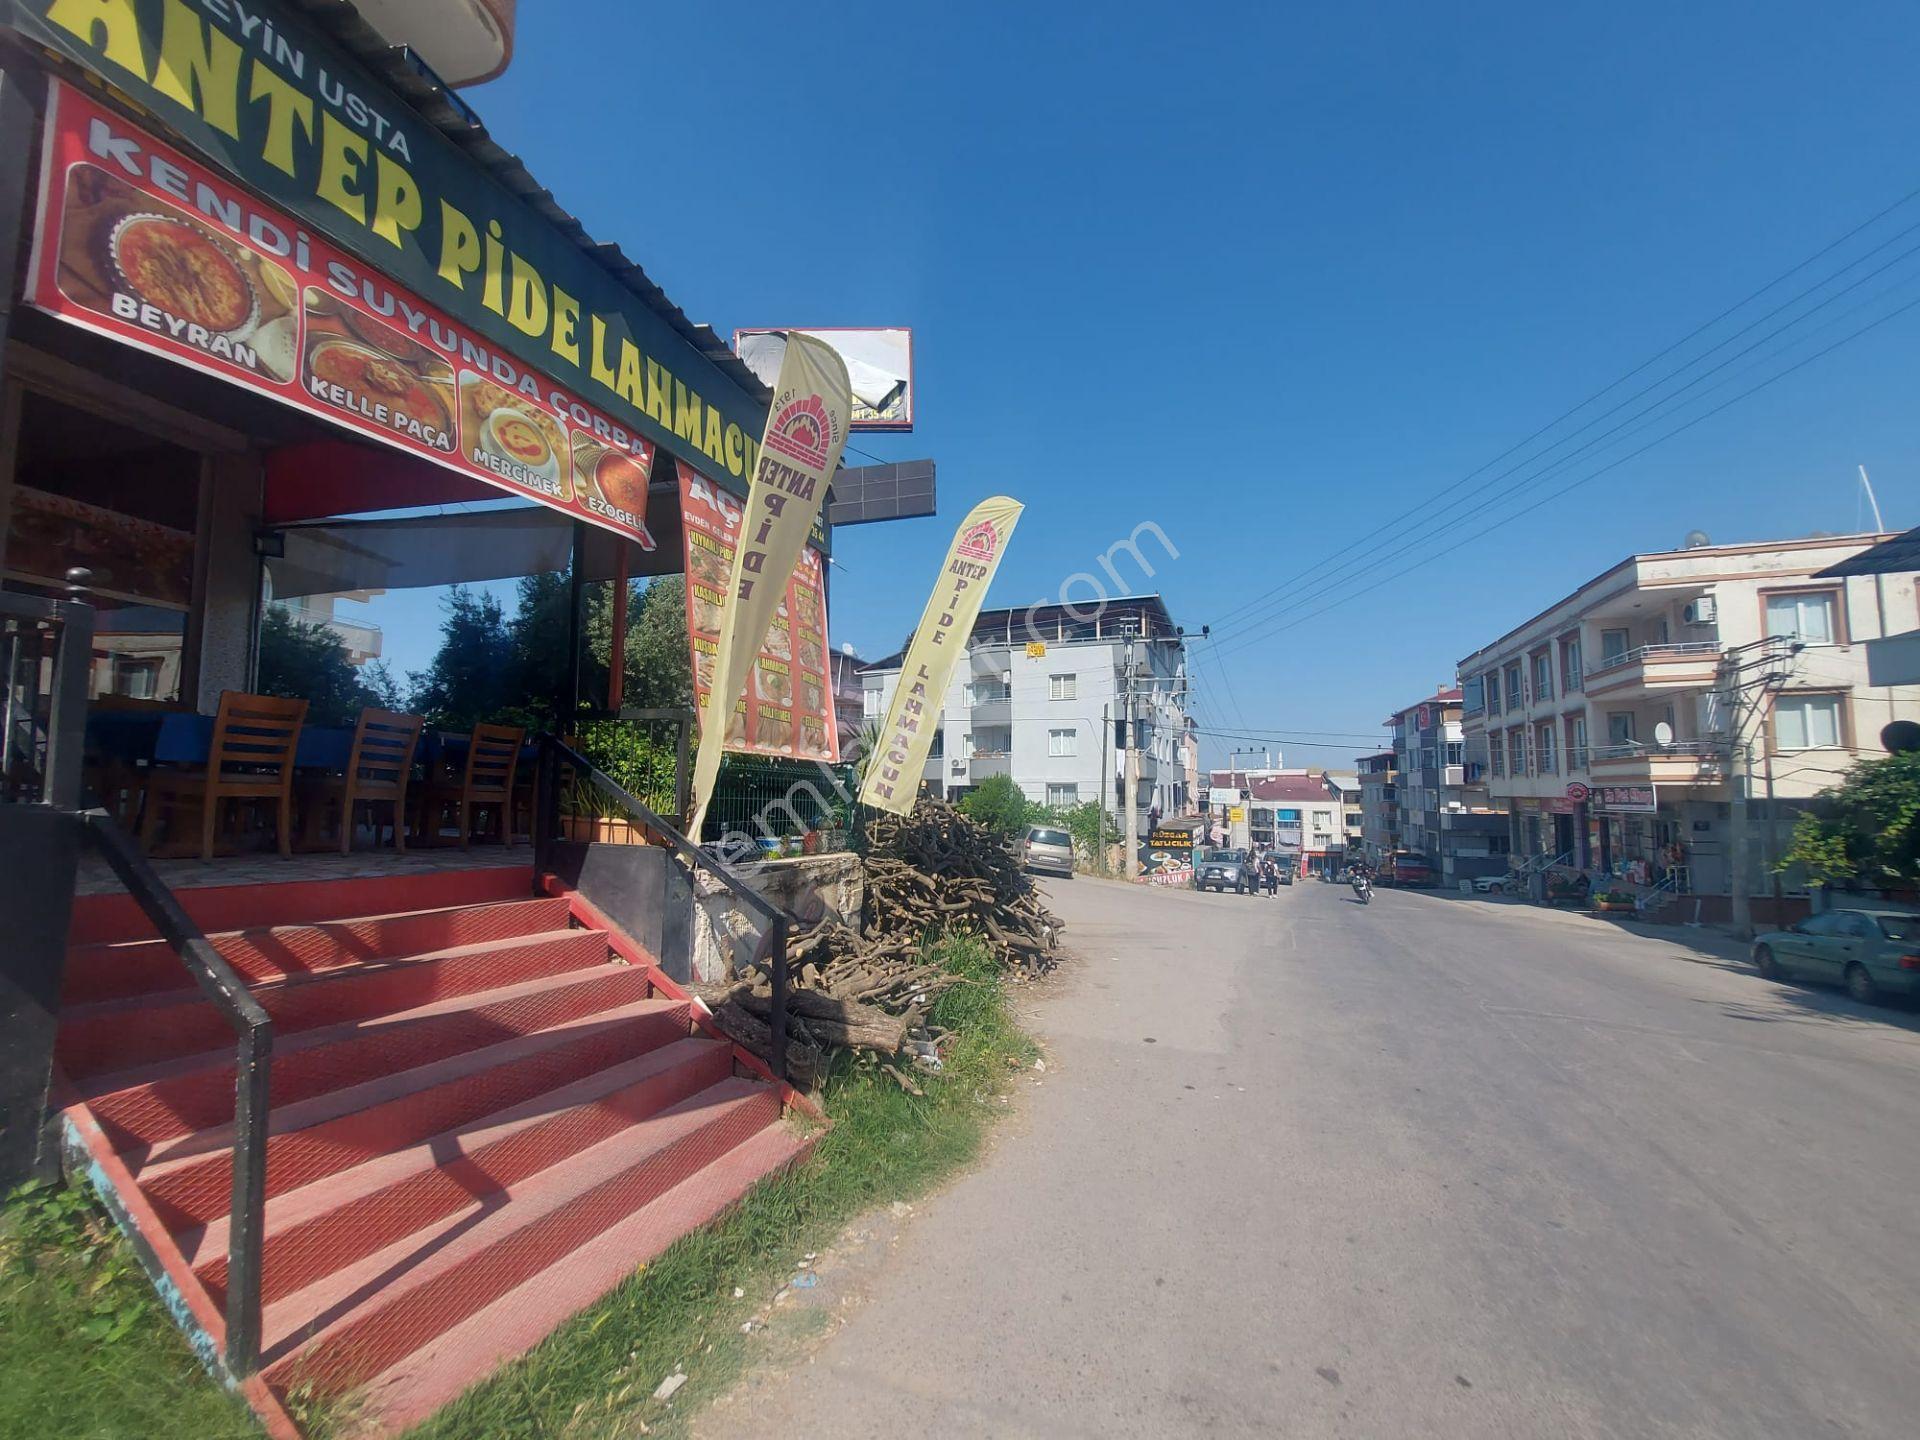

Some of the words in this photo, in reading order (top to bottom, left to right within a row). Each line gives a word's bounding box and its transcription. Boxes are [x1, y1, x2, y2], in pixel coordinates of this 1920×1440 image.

[317, 68, 412, 164] USTA
[88, 117, 310, 273] KENDİ
[327, 261, 541, 402] SUYUNDA
[549, 391, 649, 461] ÇORBA
[437, 197, 580, 368] PİDE
[110, 291, 257, 370] BEYRAN
[310, 375, 388, 424] KELLE
[394, 412, 450, 450] PAÇA
[472, 447, 564, 498] MERCİMEK
[688, 472, 746, 529] AÇ
[948, 558, 988, 581] ANTEP
[931, 577, 969, 645] PİDE
[874, 663, 930, 800] LAHMACUN
